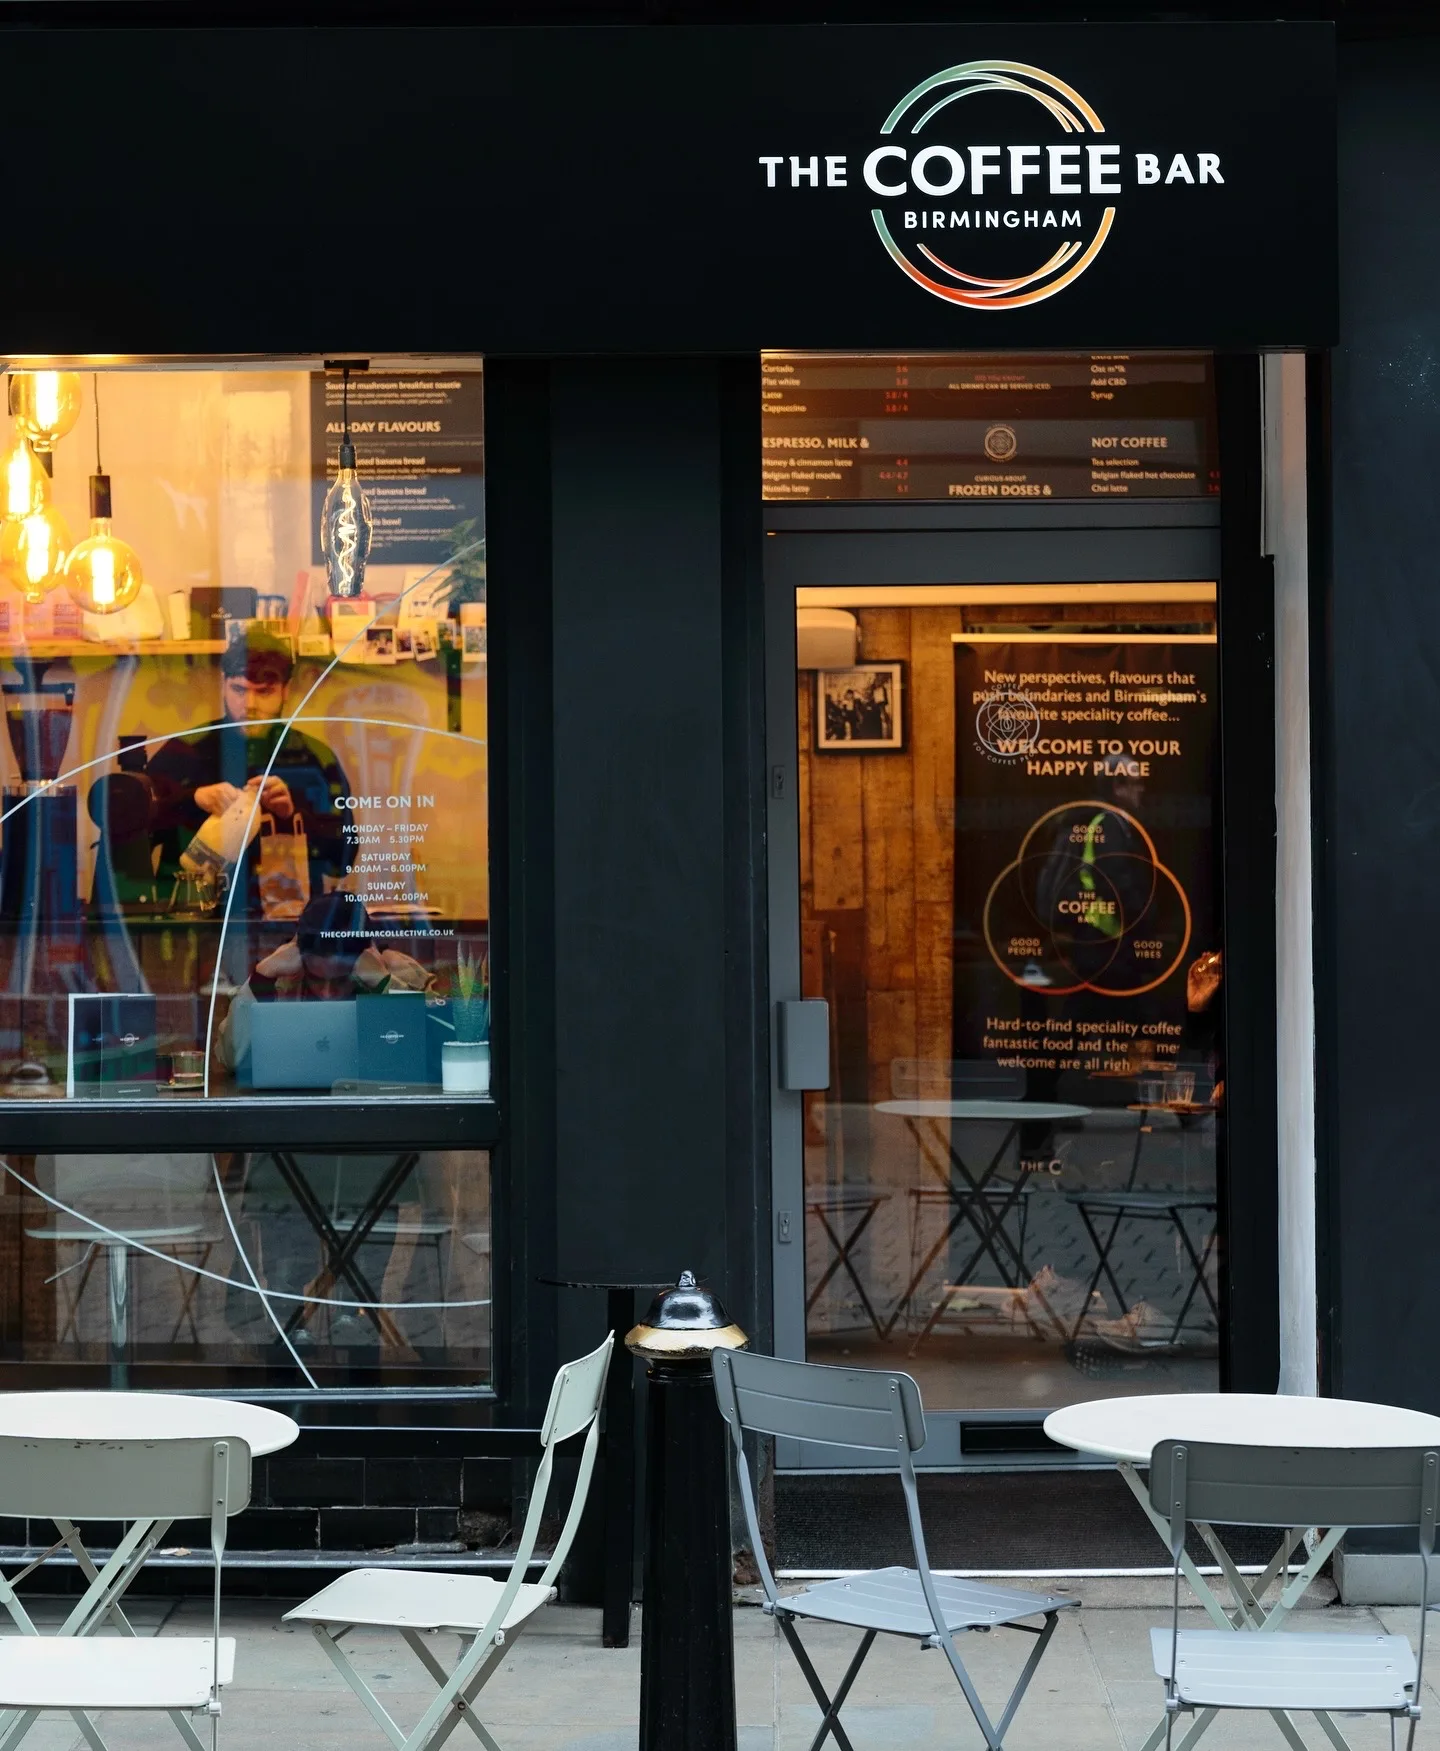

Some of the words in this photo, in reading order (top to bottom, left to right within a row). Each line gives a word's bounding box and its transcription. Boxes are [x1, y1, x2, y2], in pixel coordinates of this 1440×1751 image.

[759, 156, 848, 187] THE
[863, 144, 1121, 196] COFFEE
[1135, 153, 1225, 185] BAR
[904, 209, 1082, 229] BIRMINGHAM
[398, 381, 434, 390] breakfast
[1091, 377, 1109, 386] Add
[1109, 378, 1127, 386] CBD
[1091, 391, 1114, 401] Syrup
[325, 421, 376, 433] ALL-DAY
[378, 421, 441, 433] FLAVOURS
[762, 437, 825, 449] ESPRESSO,
[827, 437, 858, 449] MILK
[860, 437, 870, 448] &
[1091, 437, 1119, 448] NOT
[1121, 437, 1168, 448] COFFEE
[762, 458, 788, 468] Honey
[788, 458, 796, 467] &
[796, 458, 834, 467] cinnamon
[834, 458, 853, 467] latte
[1091, 458, 1104, 466] Tea
[1105, 458, 1140, 466] selection
[762, 471, 790, 481] Belgian
[791, 471, 816, 480] flaked
[816, 471, 842, 480] mocha
[1091, 471, 1120, 481] Belgian
[1120, 471, 1143, 480] flaked
[1144, 471, 1159, 480] hot
[1159, 471, 1196, 480] chocolate
[791, 484, 810, 493] latte
[948, 484, 998, 496] FROZEN
[1001, 484, 1040, 496] DOSES
[1042, 484, 1052, 496] &
[1091, 484, 1109, 493] Chai
[1109, 484, 1128, 493] latte
[984, 670, 1017, 684] New
[1019, 670, 1106, 687] perspectives,
[1109, 670, 1164, 685] flavours
[1166, 671, 1195, 685] that
[972, 688, 1006, 705] push
[1007, 687, 1082, 702] boundaries
[1085, 689, 1110, 703] and
[1114, 690, 1207, 706] Birmingham's
[997, 706, 1059, 721] favourite
[1061, 707, 1125, 725] speciality
[996, 739, 1093, 755] WELCOME
[1097, 739, 1123, 755] TO
[1127, 740, 1181, 756] YOUR
[1026, 761, 1091, 776] HAPPY
[1093, 762, 1151, 777] PLACE
[334, 796, 382, 810] COME
[386, 796, 412, 809] ON
[417, 795, 435, 807] IN
[342, 824, 385, 833] MONDAY
[394, 824, 429, 832] FRIDAY
[1072, 825, 1103, 834] GOOD
[346, 836, 381, 845] 7.30AM
[389, 835, 425, 844] 5.30PM
[1069, 835, 1106, 843] COFFEE
[361, 853, 411, 862] SATURDAY
[345, 864, 382, 873] 9.00AM
[390, 864, 426, 872] 6.00PM
[367, 882, 406, 890] SUNDAY
[344, 894, 384, 903] 10.00AM
[393, 893, 429, 902] 4.00PM
[1078, 892, 1096, 900] THE
[1058, 900, 1116, 914] COFFEE
[320, 929, 455, 938] THECOFFEEBARCOLLECTIVE.CO.UK
[1010, 938, 1041, 947] GOOD
[1133, 941, 1163, 950] GOOD
[1007, 947, 1043, 956] PEOPLE
[1135, 951, 1162, 959] VIBES
[986, 1017, 1072, 1033] Hard-to-find
[1075, 1020, 1139, 1037] speciality
[1141, 1022, 1182, 1036] coffee
[983, 1036, 1039, 1050] fantastic
[1042, 1038, 1074, 1051] food
[1077, 1039, 1101, 1052] and
[1106, 1040, 1128, 1053] the
[996, 1056, 1056, 1069] welcome
[1059, 1058, 1081, 1070] are
[1084, 1057, 1100, 1070] all
[1103, 1058, 1131, 1072] righ
[1020, 1160, 1045, 1172] THE
